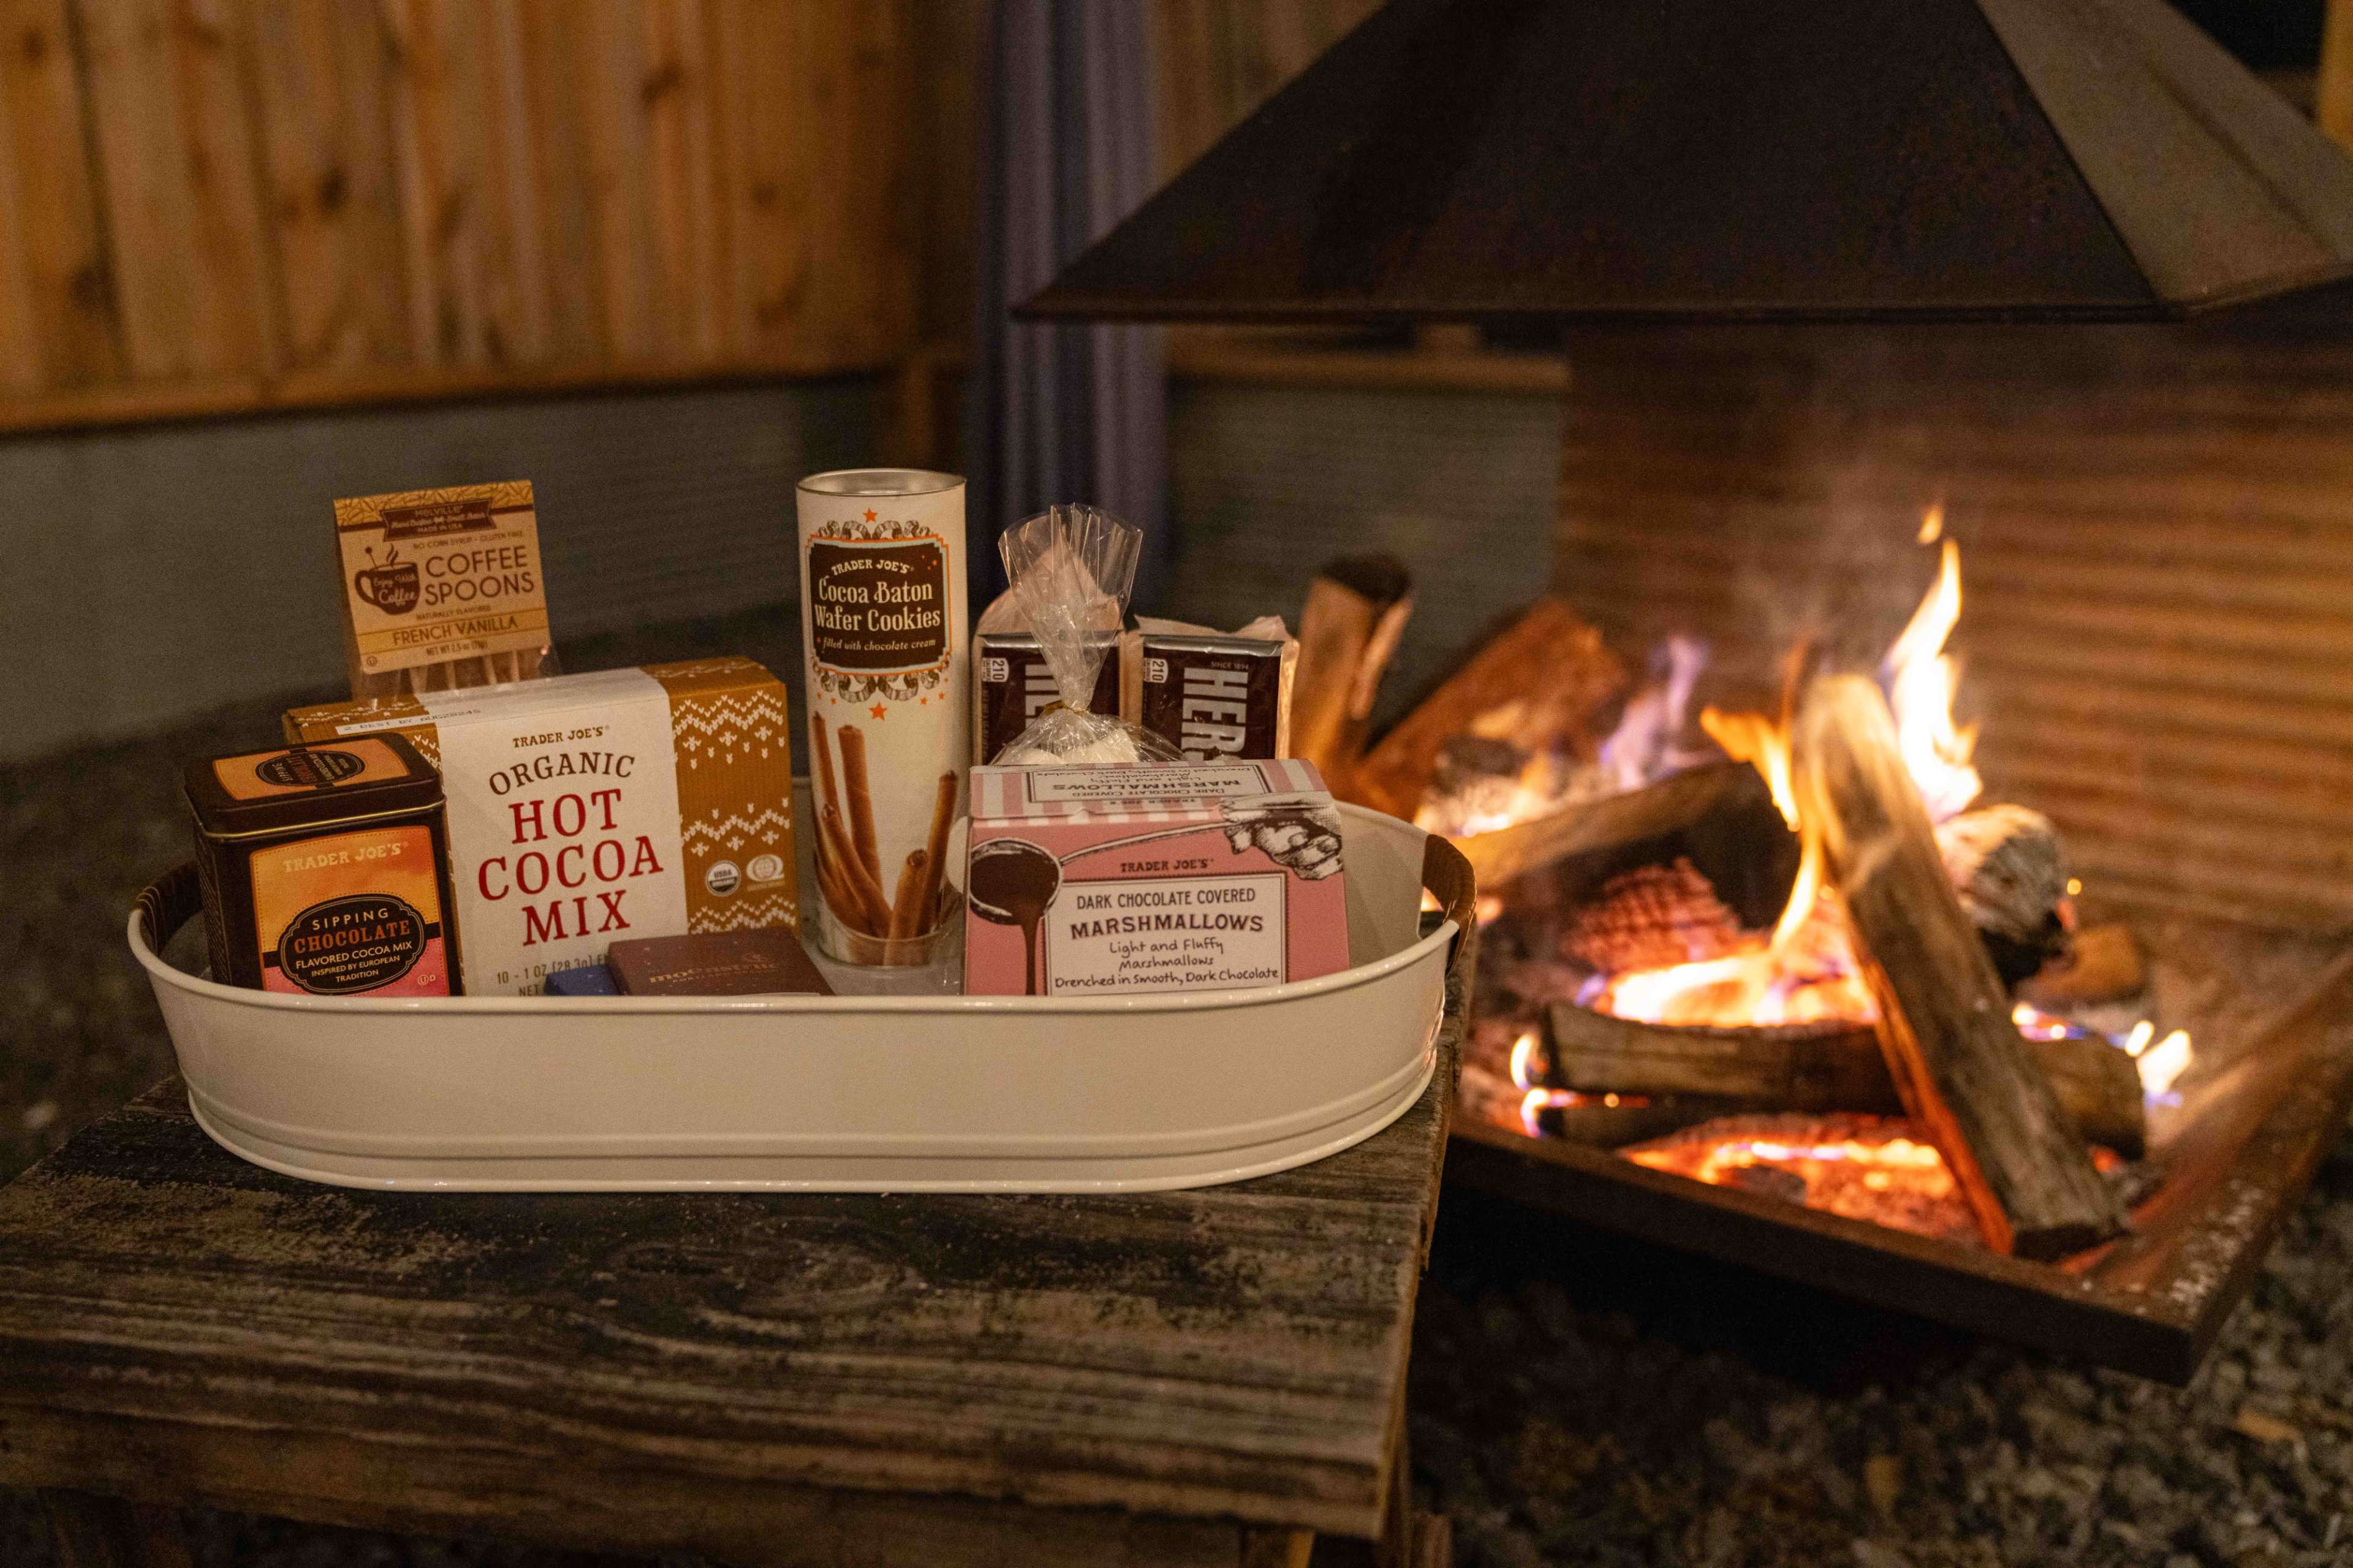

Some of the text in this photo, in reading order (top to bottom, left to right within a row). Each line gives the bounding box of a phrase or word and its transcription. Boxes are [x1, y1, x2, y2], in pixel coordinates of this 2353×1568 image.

[426, 545, 528, 578] COFFEE
[831, 558, 910, 575] TRADER JOE'S
[379, 588, 418, 608] Coffee
[425, 572, 535, 606] SPOONS
[819, 575, 933, 604] Cocoa Baton
[814, 604, 941, 632] Wafer Cookies
[393, 615, 518, 645] FRENCH VANILLA
[823, 636, 936, 651] filled with chocolate cream
[992, 660, 1005, 680] 210
[1151, 661, 1164, 682] 210
[513, 725, 604, 749] TRADER JOE'S
[489, 751, 635, 796] ORGANIC
[1053, 780, 1241, 790] MARSHMALLOWS
[509, 788, 622, 844] HOT
[282, 842, 401, 873] TRADER JOE'S
[477, 835, 664, 901] COCOA
[1120, 858, 1208, 873] TRADER JOE'S
[714, 869, 732, 878] USDA
[1077, 888, 1256, 910] DARK CHOCOLATE COVERED
[312, 907, 389, 930] SIPPING
[522, 889, 631, 947] MIX
[1070, 913, 1264, 940] MARSHMALLOWS
[294, 920, 410, 955] CHOCOLATE
[1110, 937, 1224, 958] Light and Fluffy
[295, 941, 412, 970] FLAVORED COCOA MIX
[311, 955, 400, 977] INSPIRED BY EUROPEAN
[1118, 955, 1214, 972] Marshmallows
[335, 969, 379, 983] TRADITION
[497, 971, 509, 985] 10
[524, 968, 529, 979] 1
[534, 964, 547, 978] OZ
[1055, 968, 1279, 988] Drenched in Smooth, Dark Chocolate
[519, 984, 539, 996] NET
